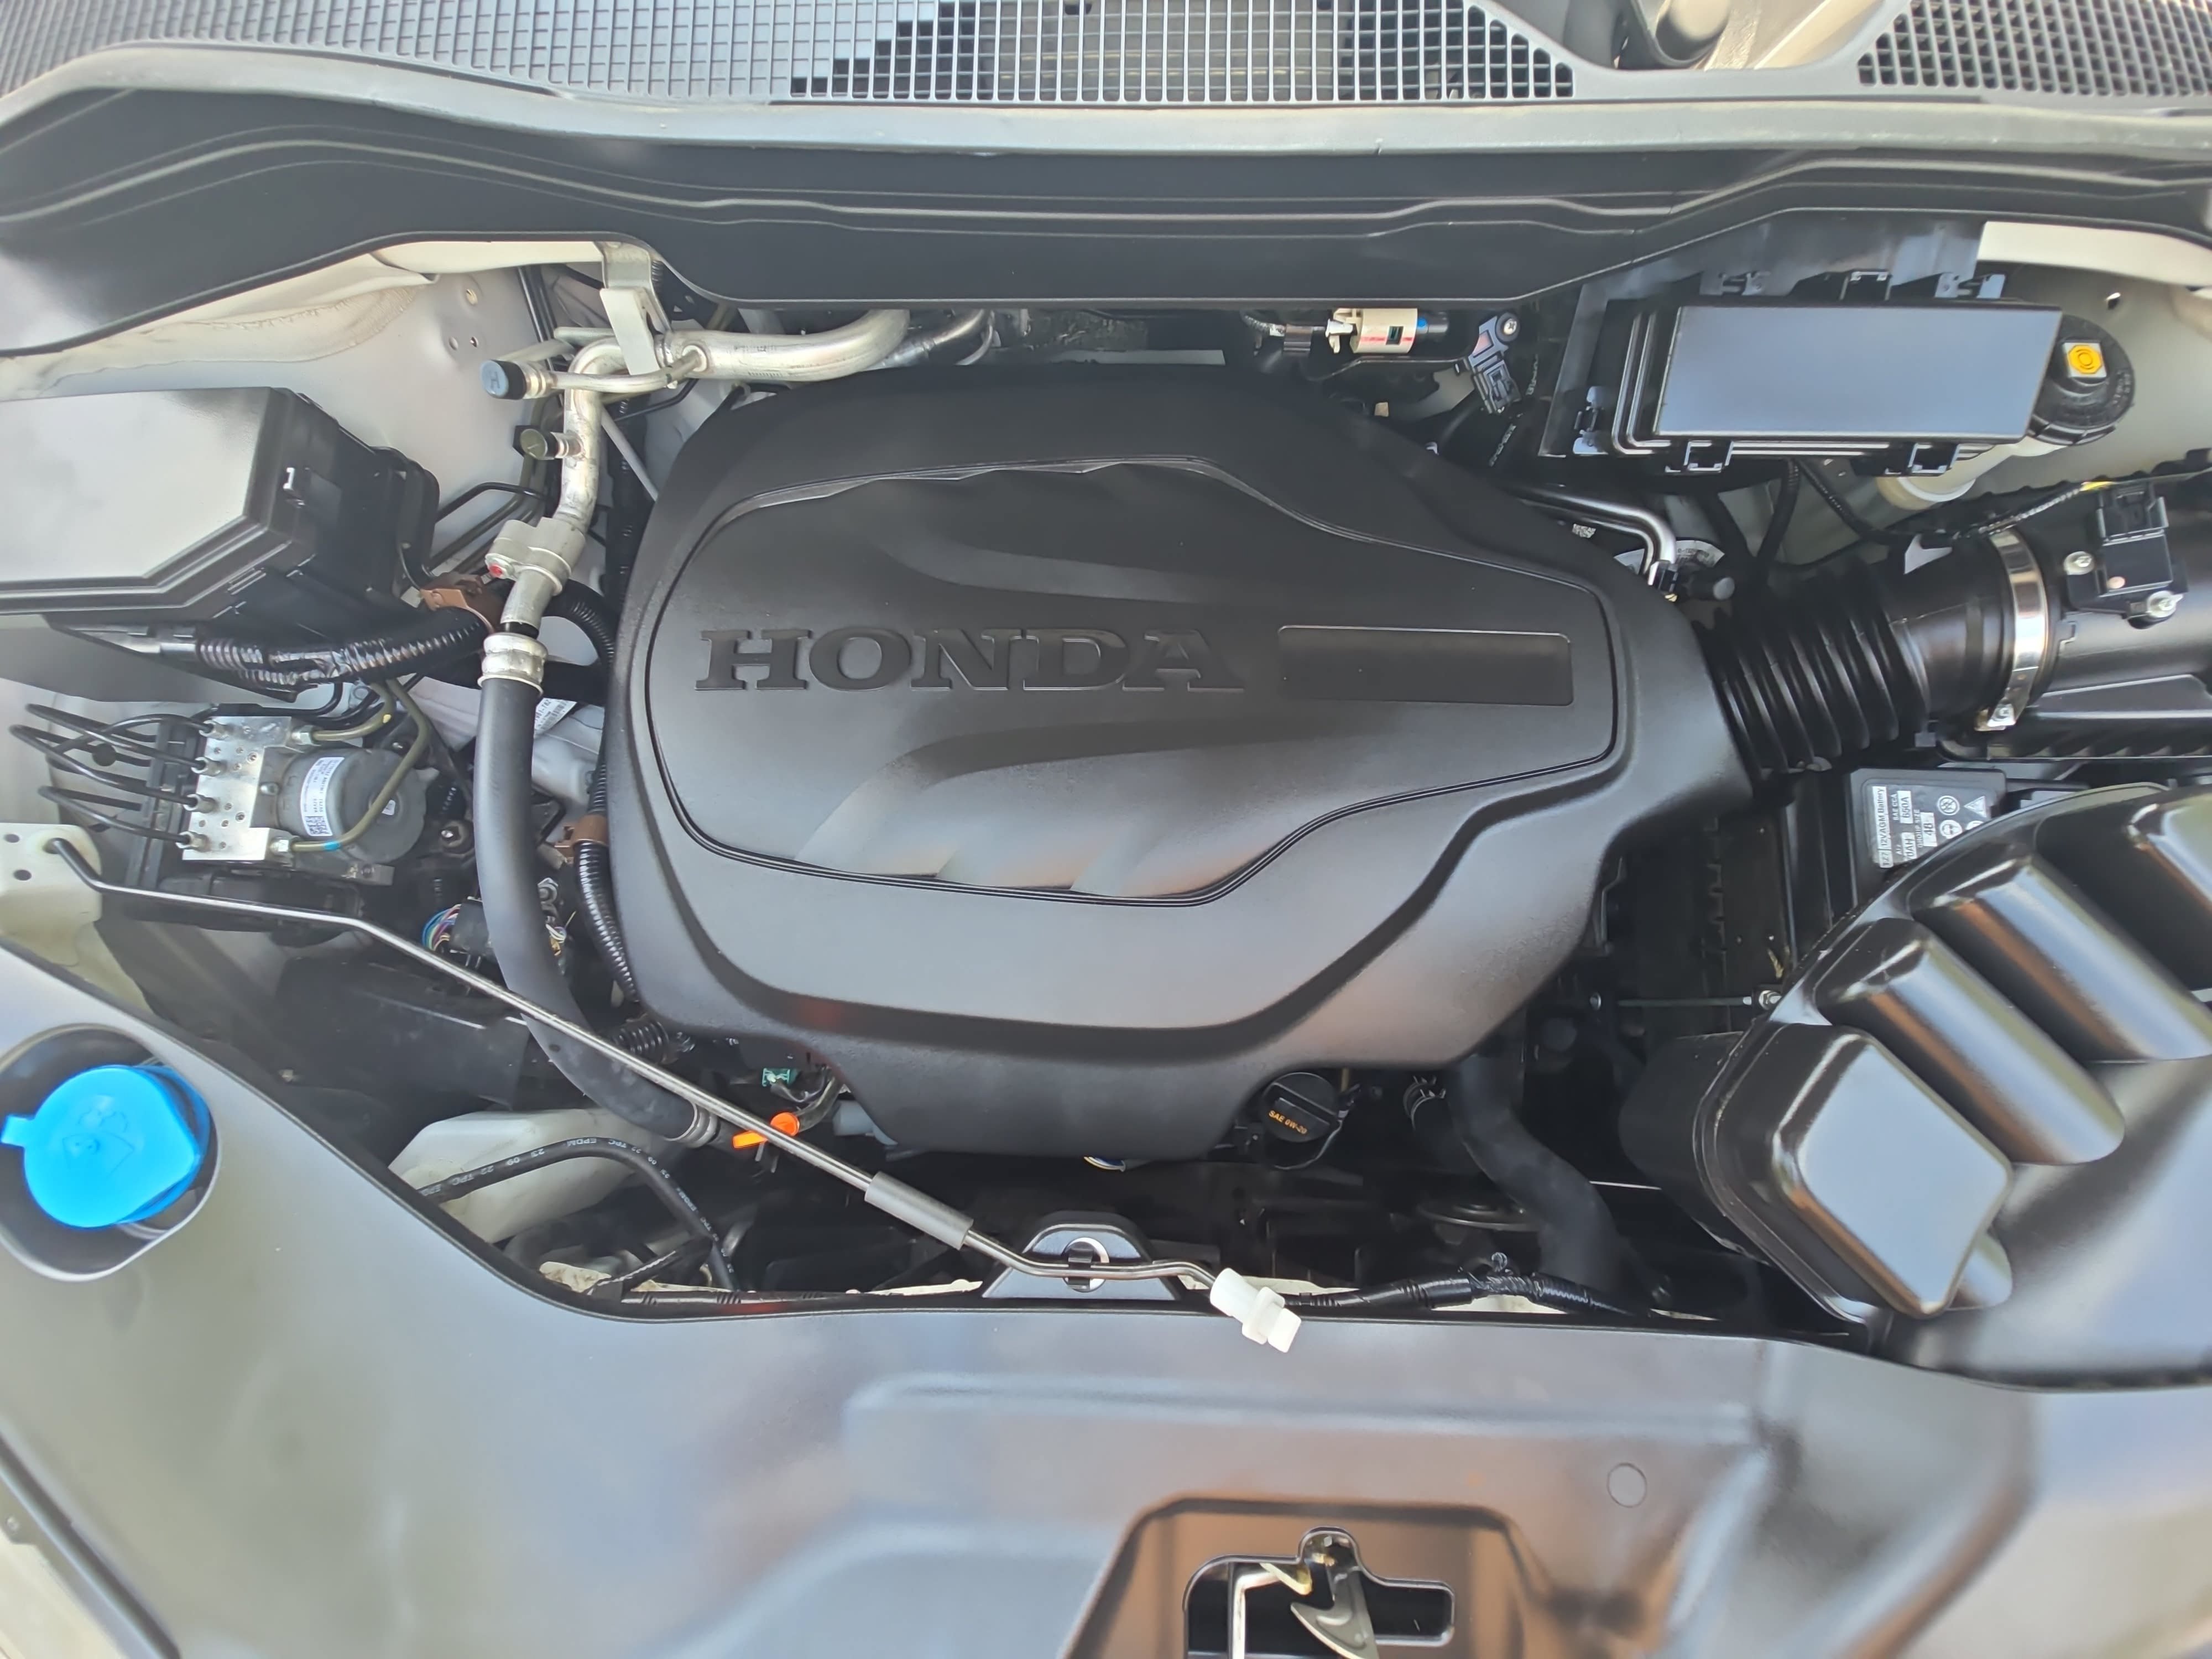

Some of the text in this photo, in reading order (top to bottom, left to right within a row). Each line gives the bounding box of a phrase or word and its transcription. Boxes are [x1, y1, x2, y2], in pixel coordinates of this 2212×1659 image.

[695, 627, 1244, 691] HONDA
[1877, 788, 1885, 813] Battery
[1901, 796, 1911, 818] 650A
[1923, 823, 1934, 836] 48
[1269, 1110, 1307, 1134] SAE 0W-20
[567, 1138, 597, 1147] EPDM
[608, 1139, 627, 1148] TPC
[531, 1148, 545, 1158] 23
[505, 1157, 520, 1166] 09
[480, 1165, 494, 1175] 22
[452, 1173, 474, 1186] TPC
